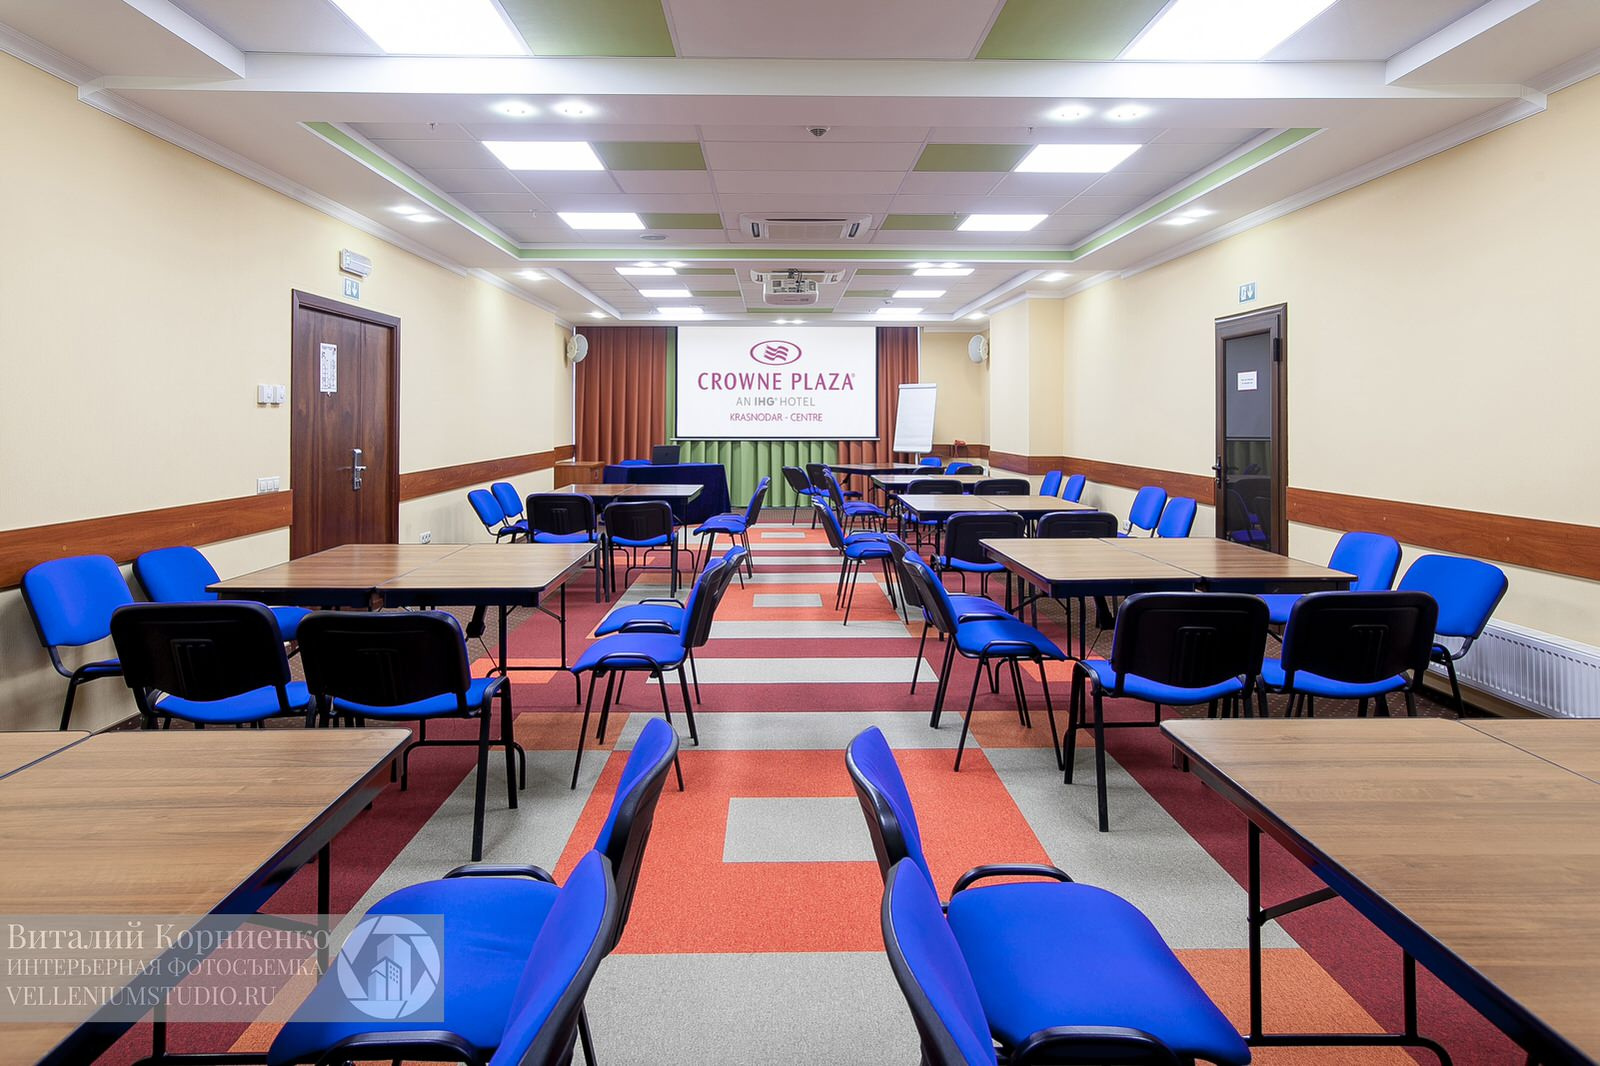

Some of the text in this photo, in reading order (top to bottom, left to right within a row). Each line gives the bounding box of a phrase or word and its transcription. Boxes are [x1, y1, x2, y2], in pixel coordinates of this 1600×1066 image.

[698, 372, 782, 391] CROWNE
[736, 396, 751, 407] AN
[780, 396, 815, 407] HOTEL
[730, 413, 783, 422] KRASNODAR
[790, 413, 823, 422] CENTRE
